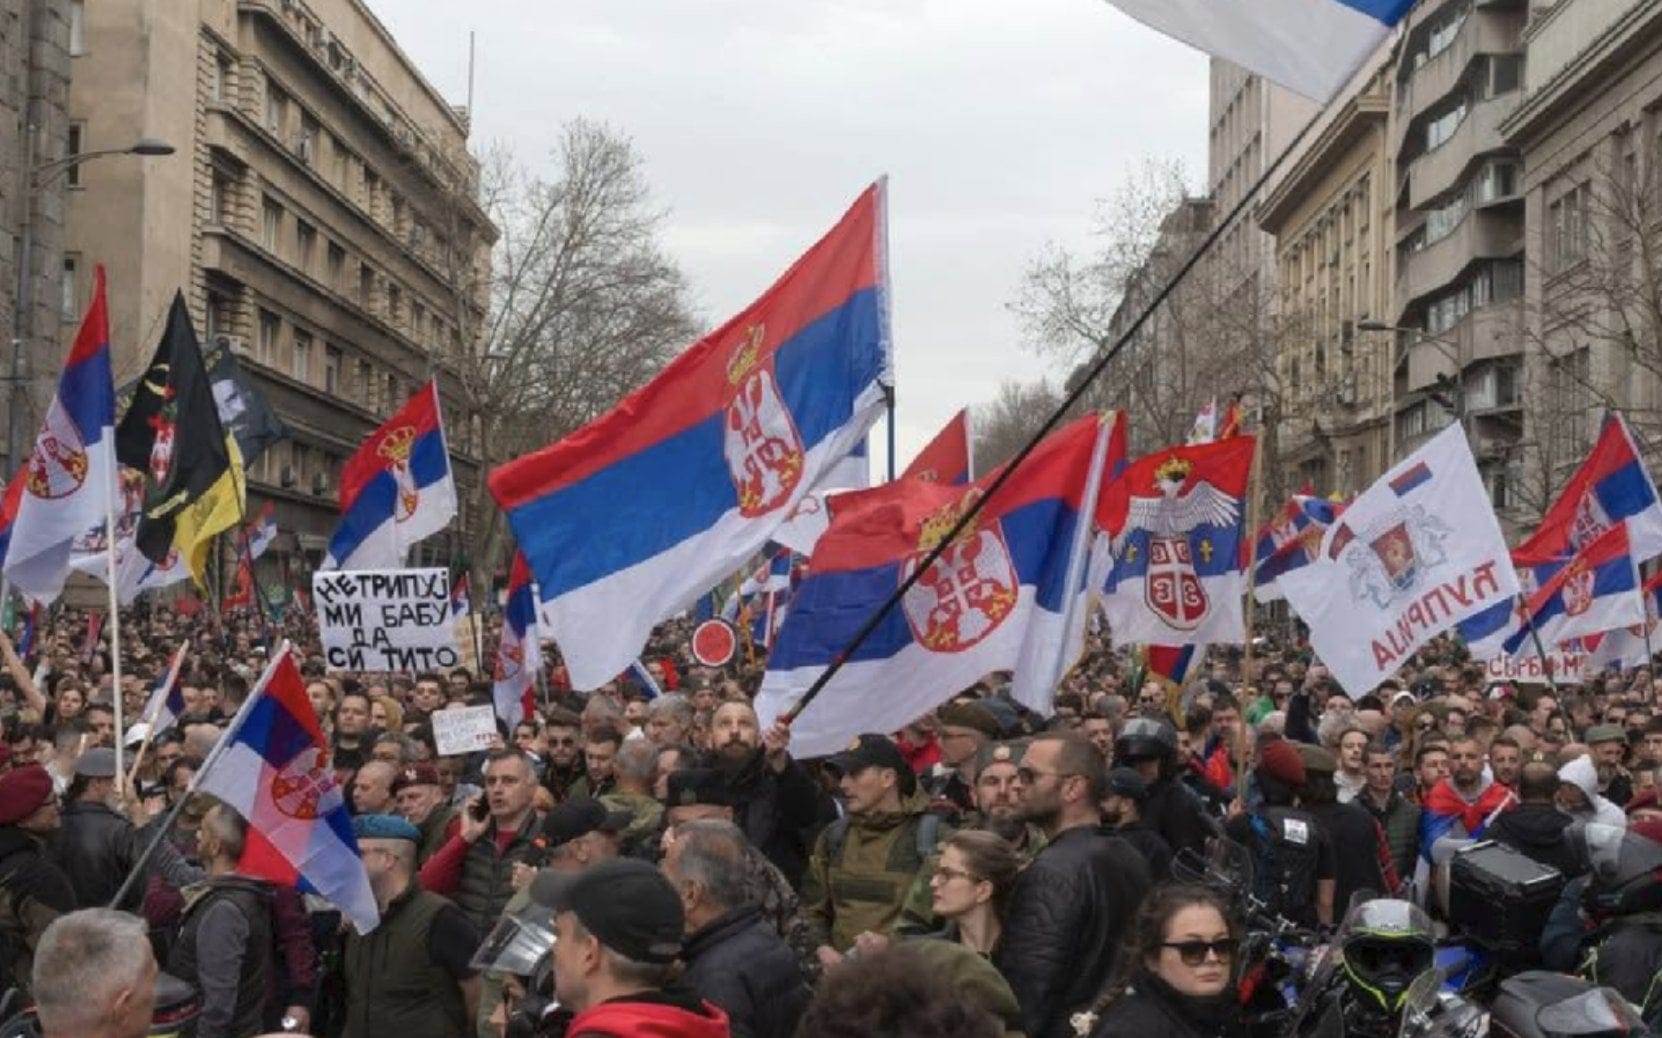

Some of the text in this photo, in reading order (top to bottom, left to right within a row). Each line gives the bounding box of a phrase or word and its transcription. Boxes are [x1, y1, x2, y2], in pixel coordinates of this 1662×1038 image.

[325, 602, 449, 628] МИ БАБУ
[351, 627, 392, 649] ДА
[328, 647, 458, 670] СИ ТИТО
